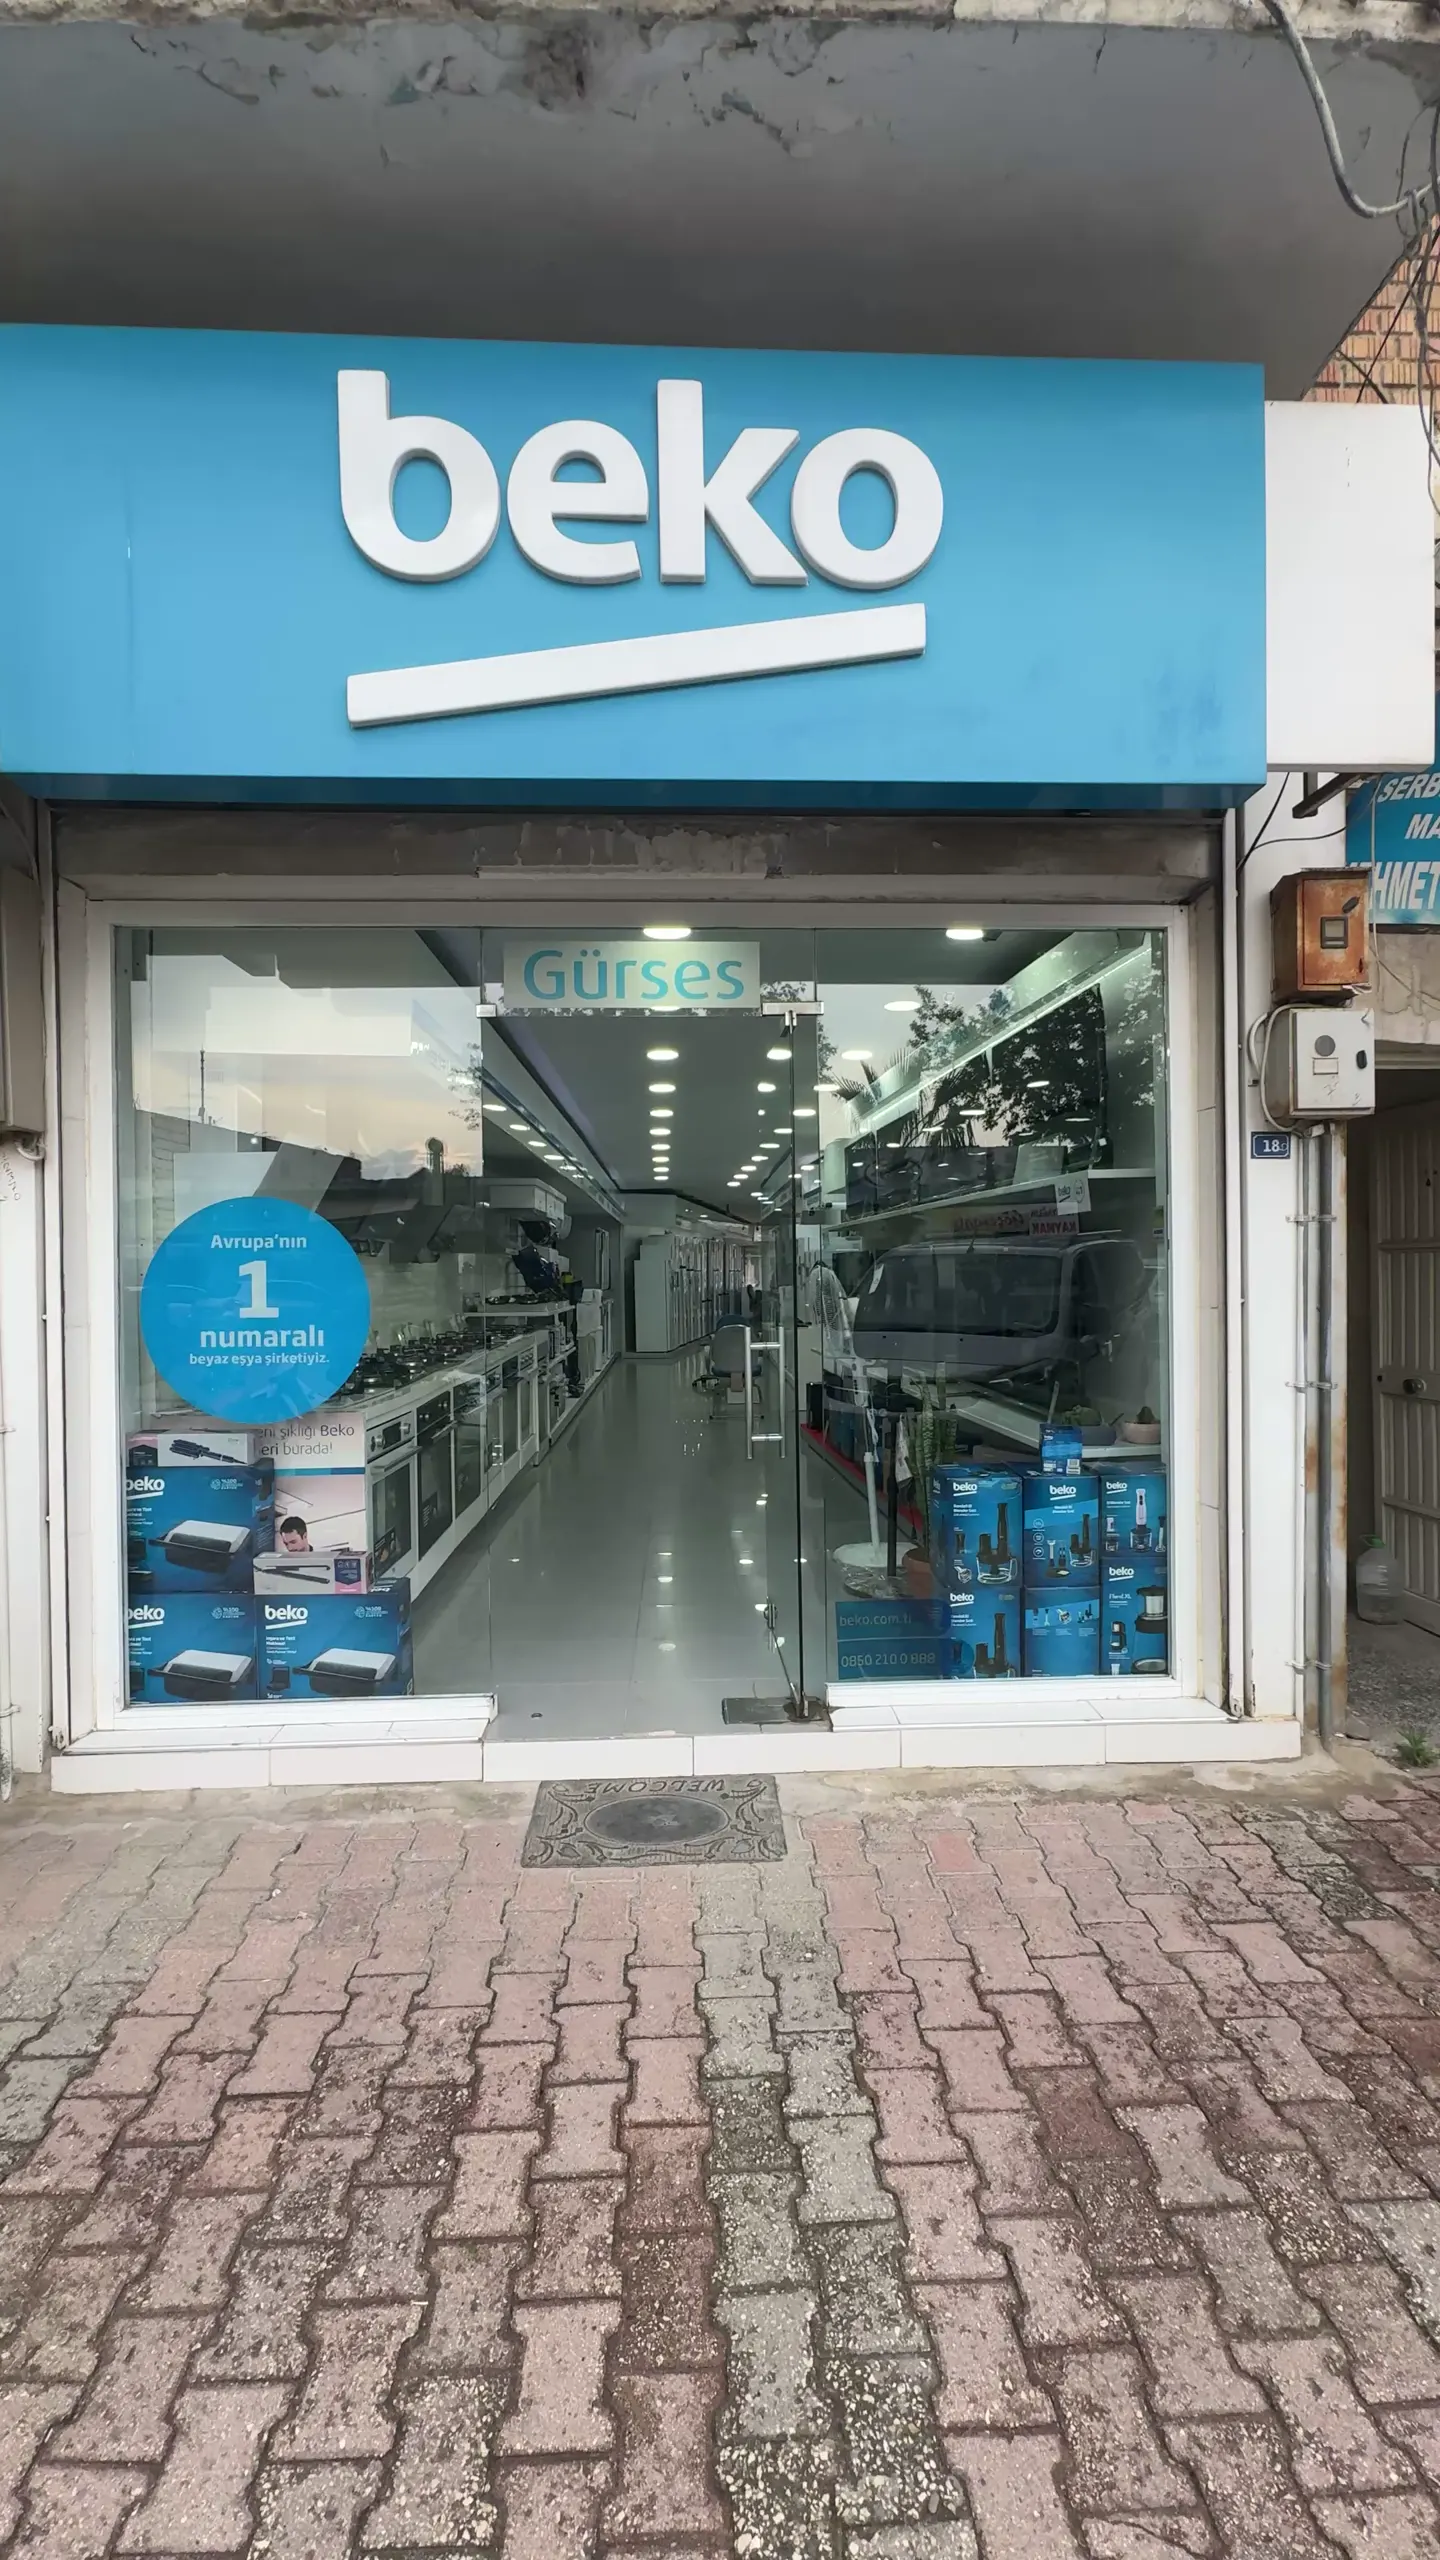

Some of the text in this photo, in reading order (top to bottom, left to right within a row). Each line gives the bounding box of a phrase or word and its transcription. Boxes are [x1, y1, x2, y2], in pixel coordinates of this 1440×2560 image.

[338, 369, 944, 590] beko
[1348, 861, 1440, 910] HMET
[523, 949, 744, 1000] Gürses
[239, 1260, 279, 1318] 1
[200, 1325, 324, 1348] numaralı
[189, 1352, 330, 1367] beyaz eşya şirketiyiz.
[320, 1424, 355, 1437] Beko
[283, 1442, 333, 1455] burada!
[953, 1482, 977, 1491] beko
[1049, 1485, 1076, 1494] beko
[1106, 1481, 1128, 1489] beko
[1109, 1566, 1135, 1576] beko
[950, 1593, 975, 1602] beko
[264, 1604, 308, 1620] beko
[841, 1654, 872, 1667] 0850
[875, 1653, 898, 1665] 210
[584, 1779, 725, 1794] WELCOME
